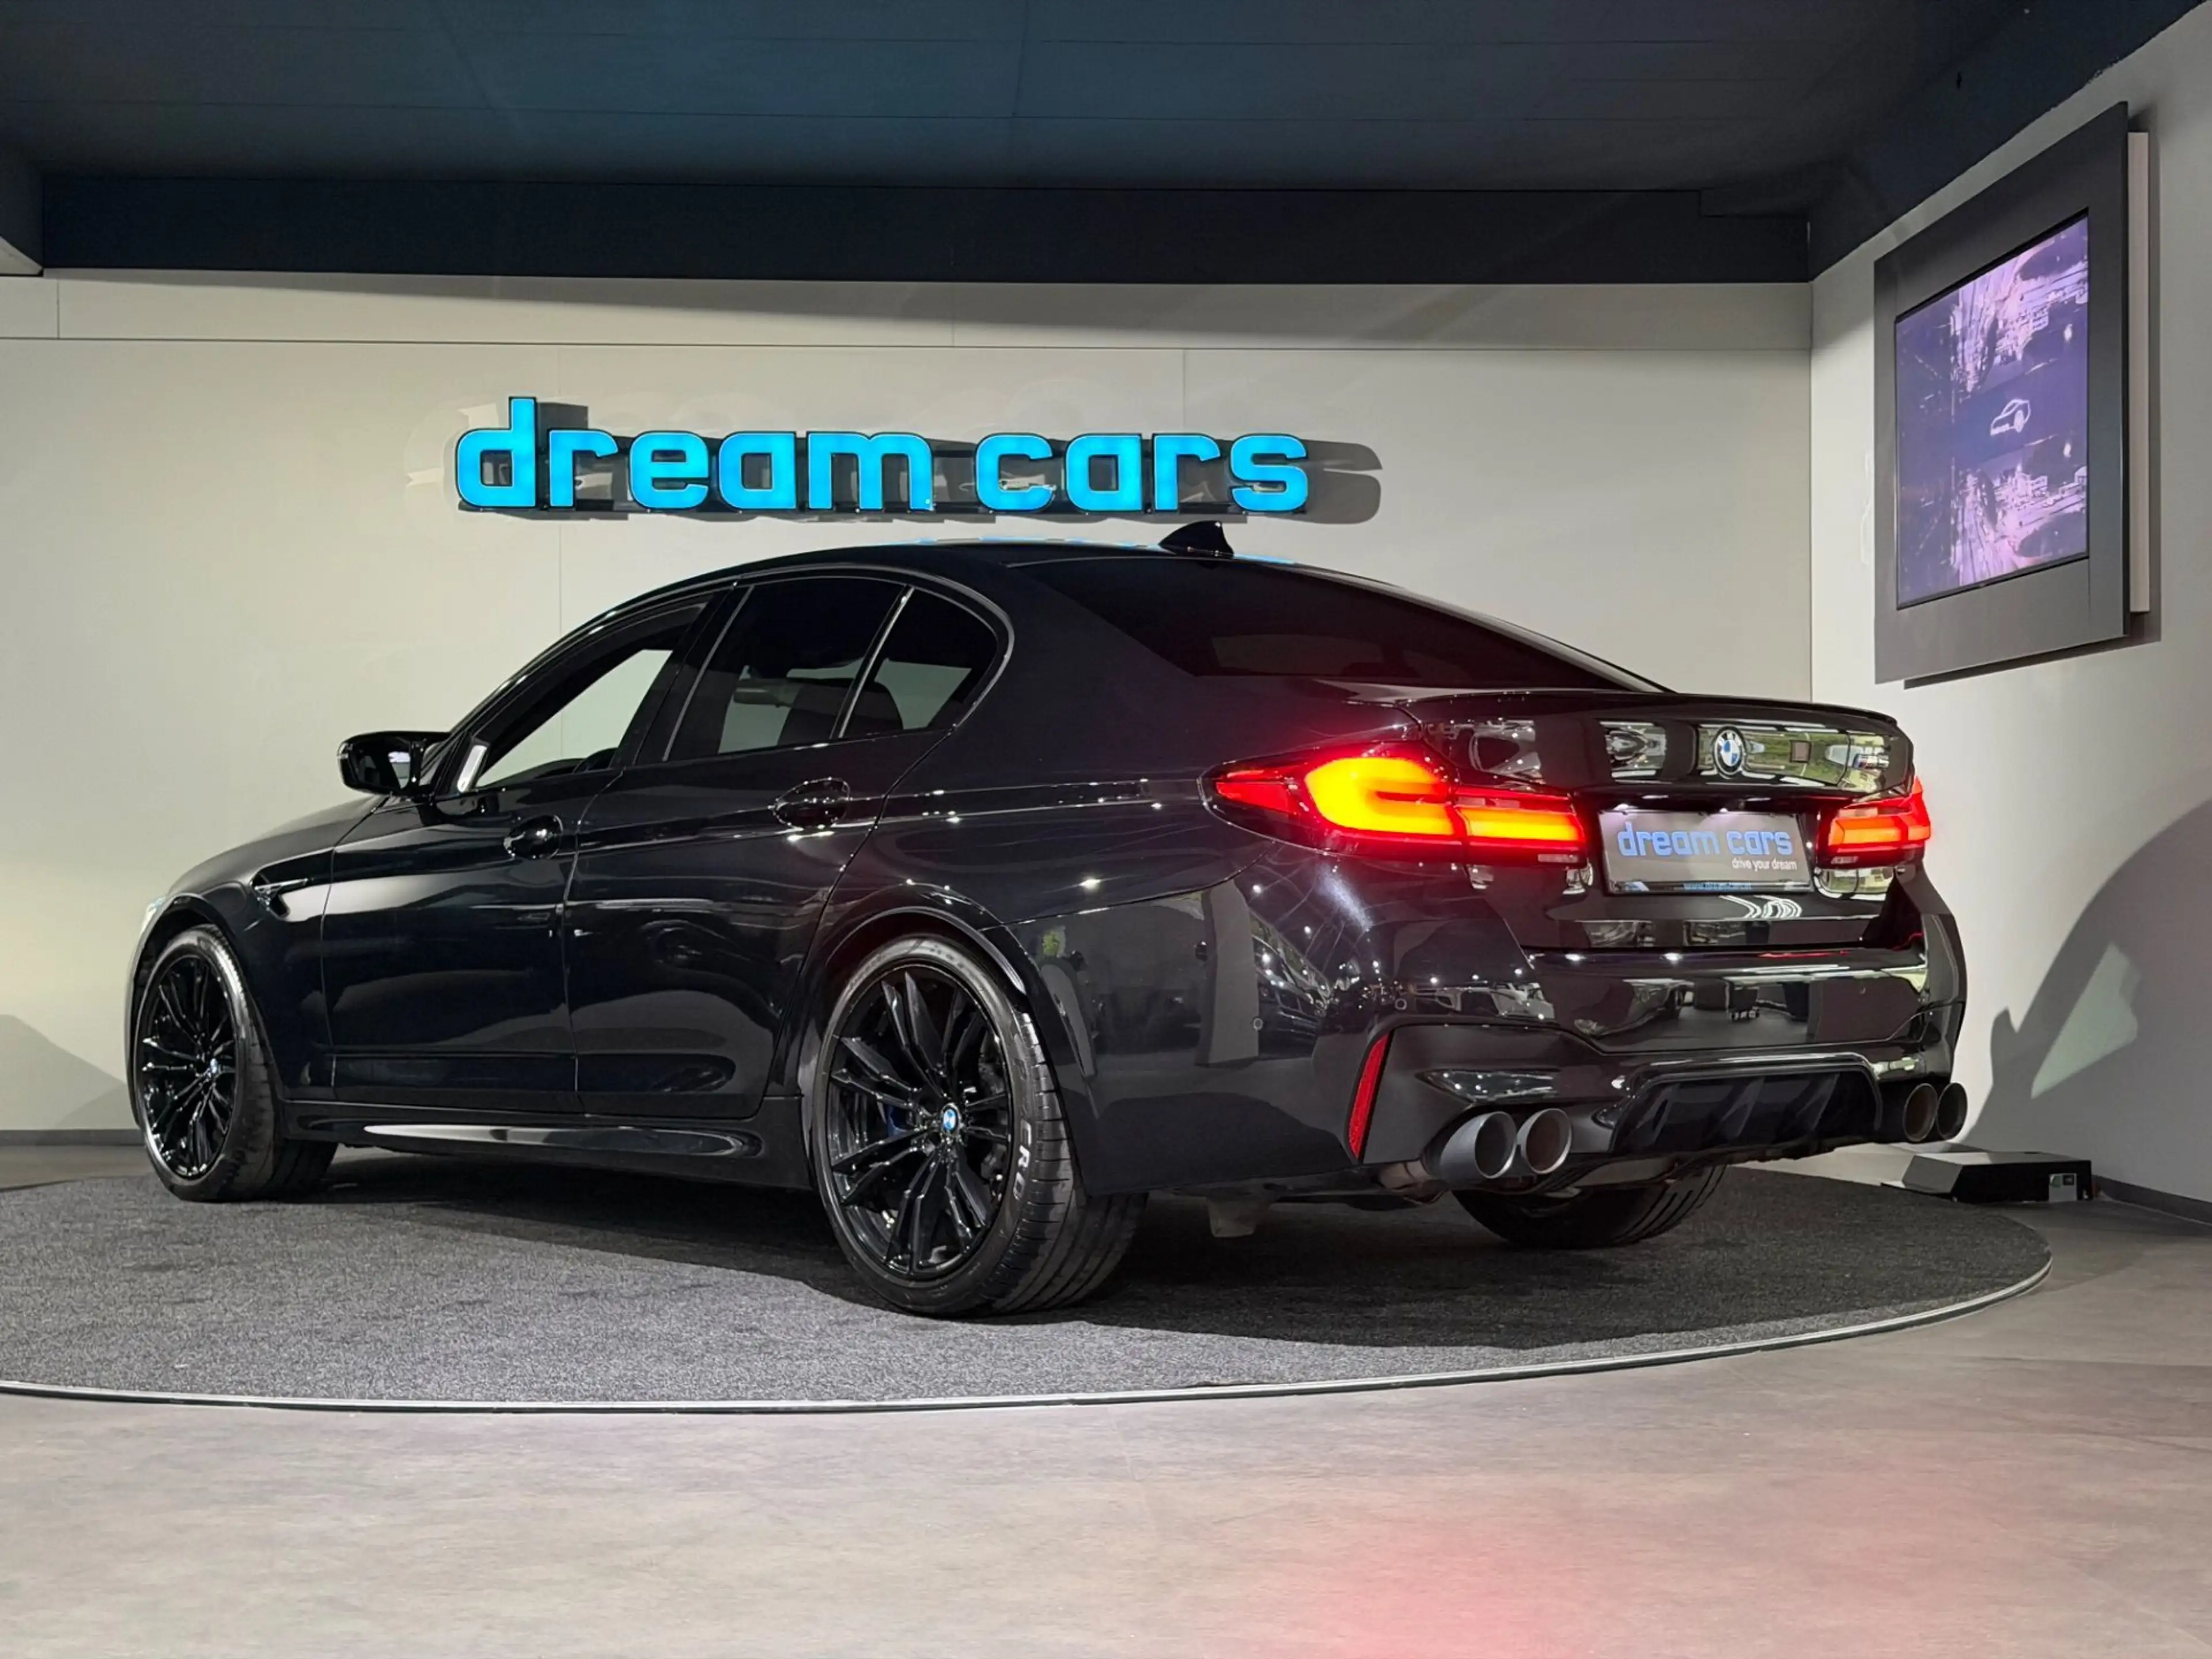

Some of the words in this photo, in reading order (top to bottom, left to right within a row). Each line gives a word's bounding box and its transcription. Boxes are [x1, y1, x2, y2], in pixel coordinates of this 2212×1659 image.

[456, 396, 934, 513] dream
[975, 432, 1309, 513] cars
[1618, 821, 1721, 857] dream
[1727, 830, 1793, 856] cars
[1732, 858, 1751, 869] drive
[1752, 859, 1770, 872] your
[1771, 857, 1797, 871] dream
